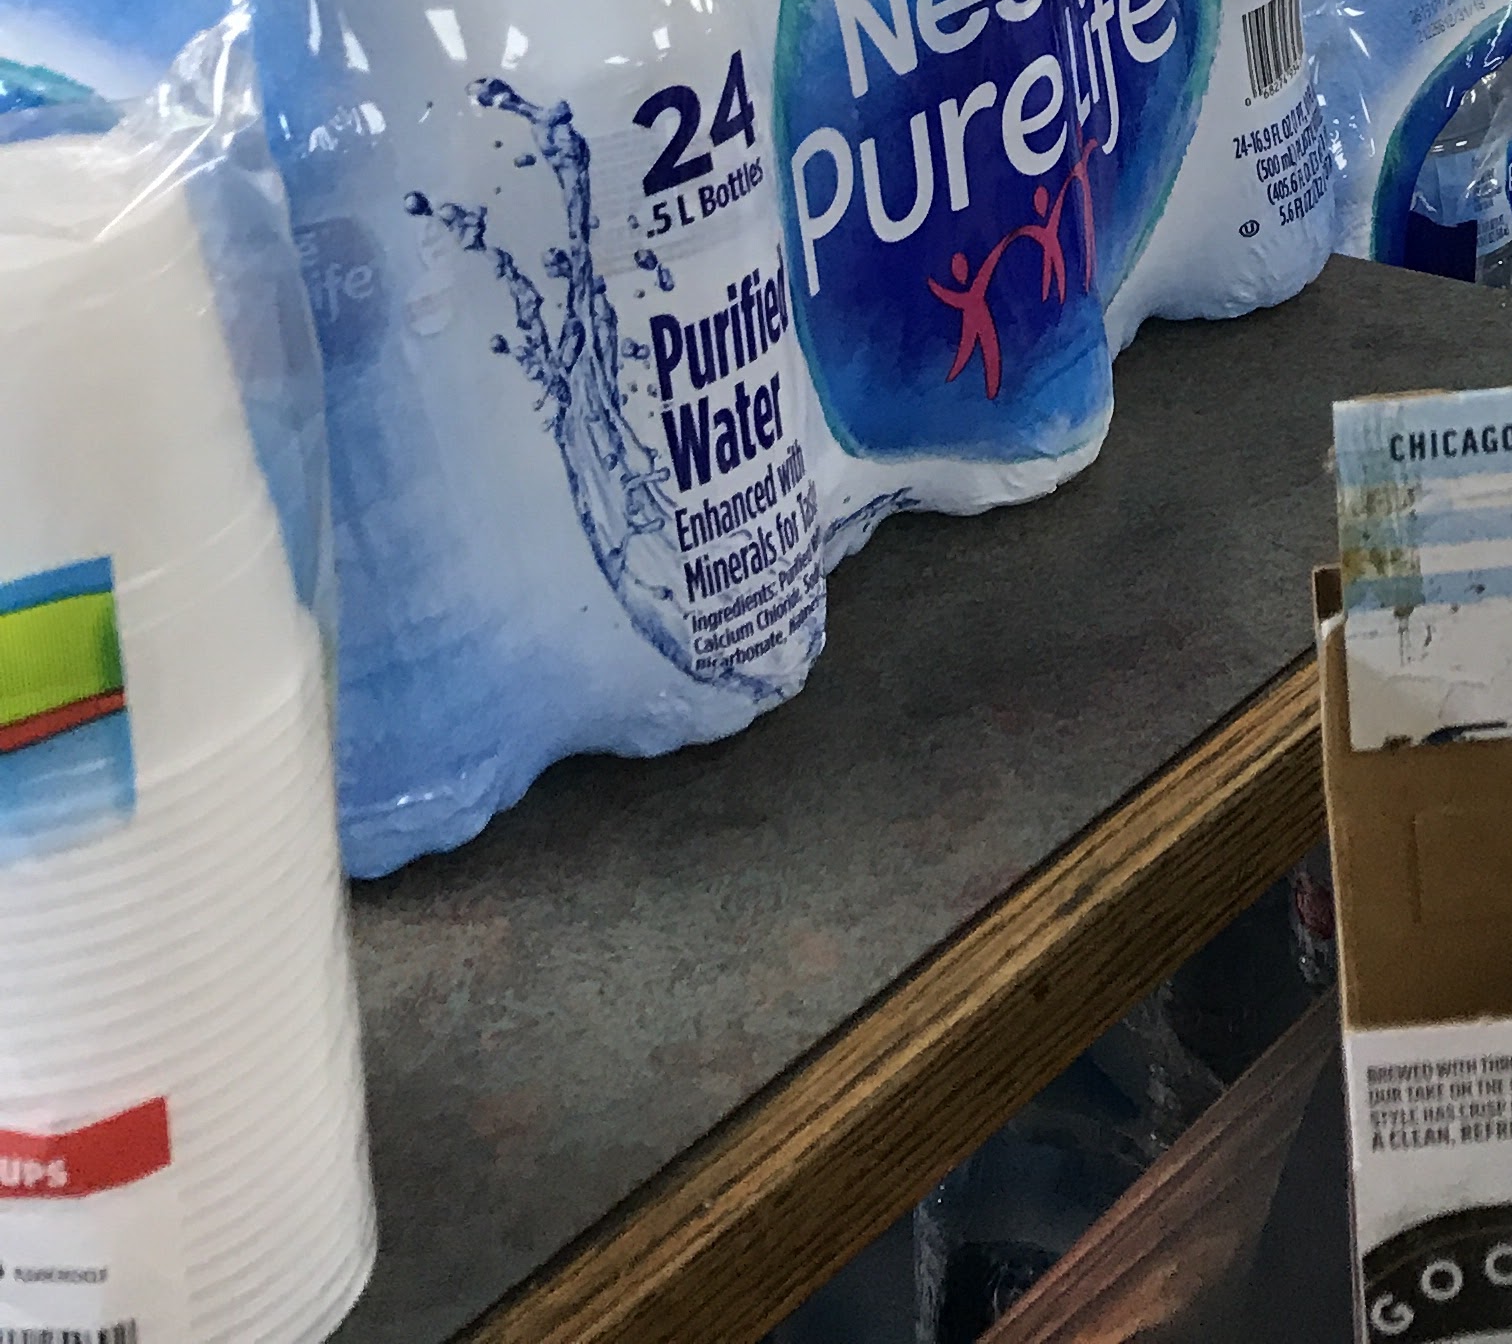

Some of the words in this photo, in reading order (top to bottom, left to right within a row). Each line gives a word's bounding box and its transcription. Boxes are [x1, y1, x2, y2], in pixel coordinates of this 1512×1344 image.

[631, 48, 758, 198] 24
[1232, 127, 1272, 160] 24-16.9
[1271, 123, 1283, 146] FL
[793, 50, 1068, 296] Pure
[1256, 154, 1280, 184] (500
[646, 200, 675, 238] .5
[679, 198, 698, 226] L
[699, 155, 765, 221] Bottles
[1267, 175, 1298, 206] (405.6
[1279, 201, 1295, 227] 5.6
[650, 242, 790, 402] Purified
[660, 370, 785, 495] Water
[674, 462, 776, 554] Enhanced
[776, 438, 808, 497] with
[682, 520, 778, 605] Minerals
[774, 509, 801, 559] for
[691, 579, 780, 636] Ingredients:
[692, 616, 755, 656] Calcium
[1435, 1058, 1477, 1077] WITH
[1368, 1087, 1402, 1107] OUR
[1405, 1082, 1445, 1103] TAKE
[1449, 1079, 1473, 1097] ON
[1477, 1076, 1504, 1095] THE
[1422, 1103, 1456, 1123] HAS
[1459, 1098, 1508, 1118] CRISP
[1371, 1130, 1385, 1153] A
[1388, 1126, 1457, 1151] CLEAN,
[0, 1158, 68, 1189] UPS
